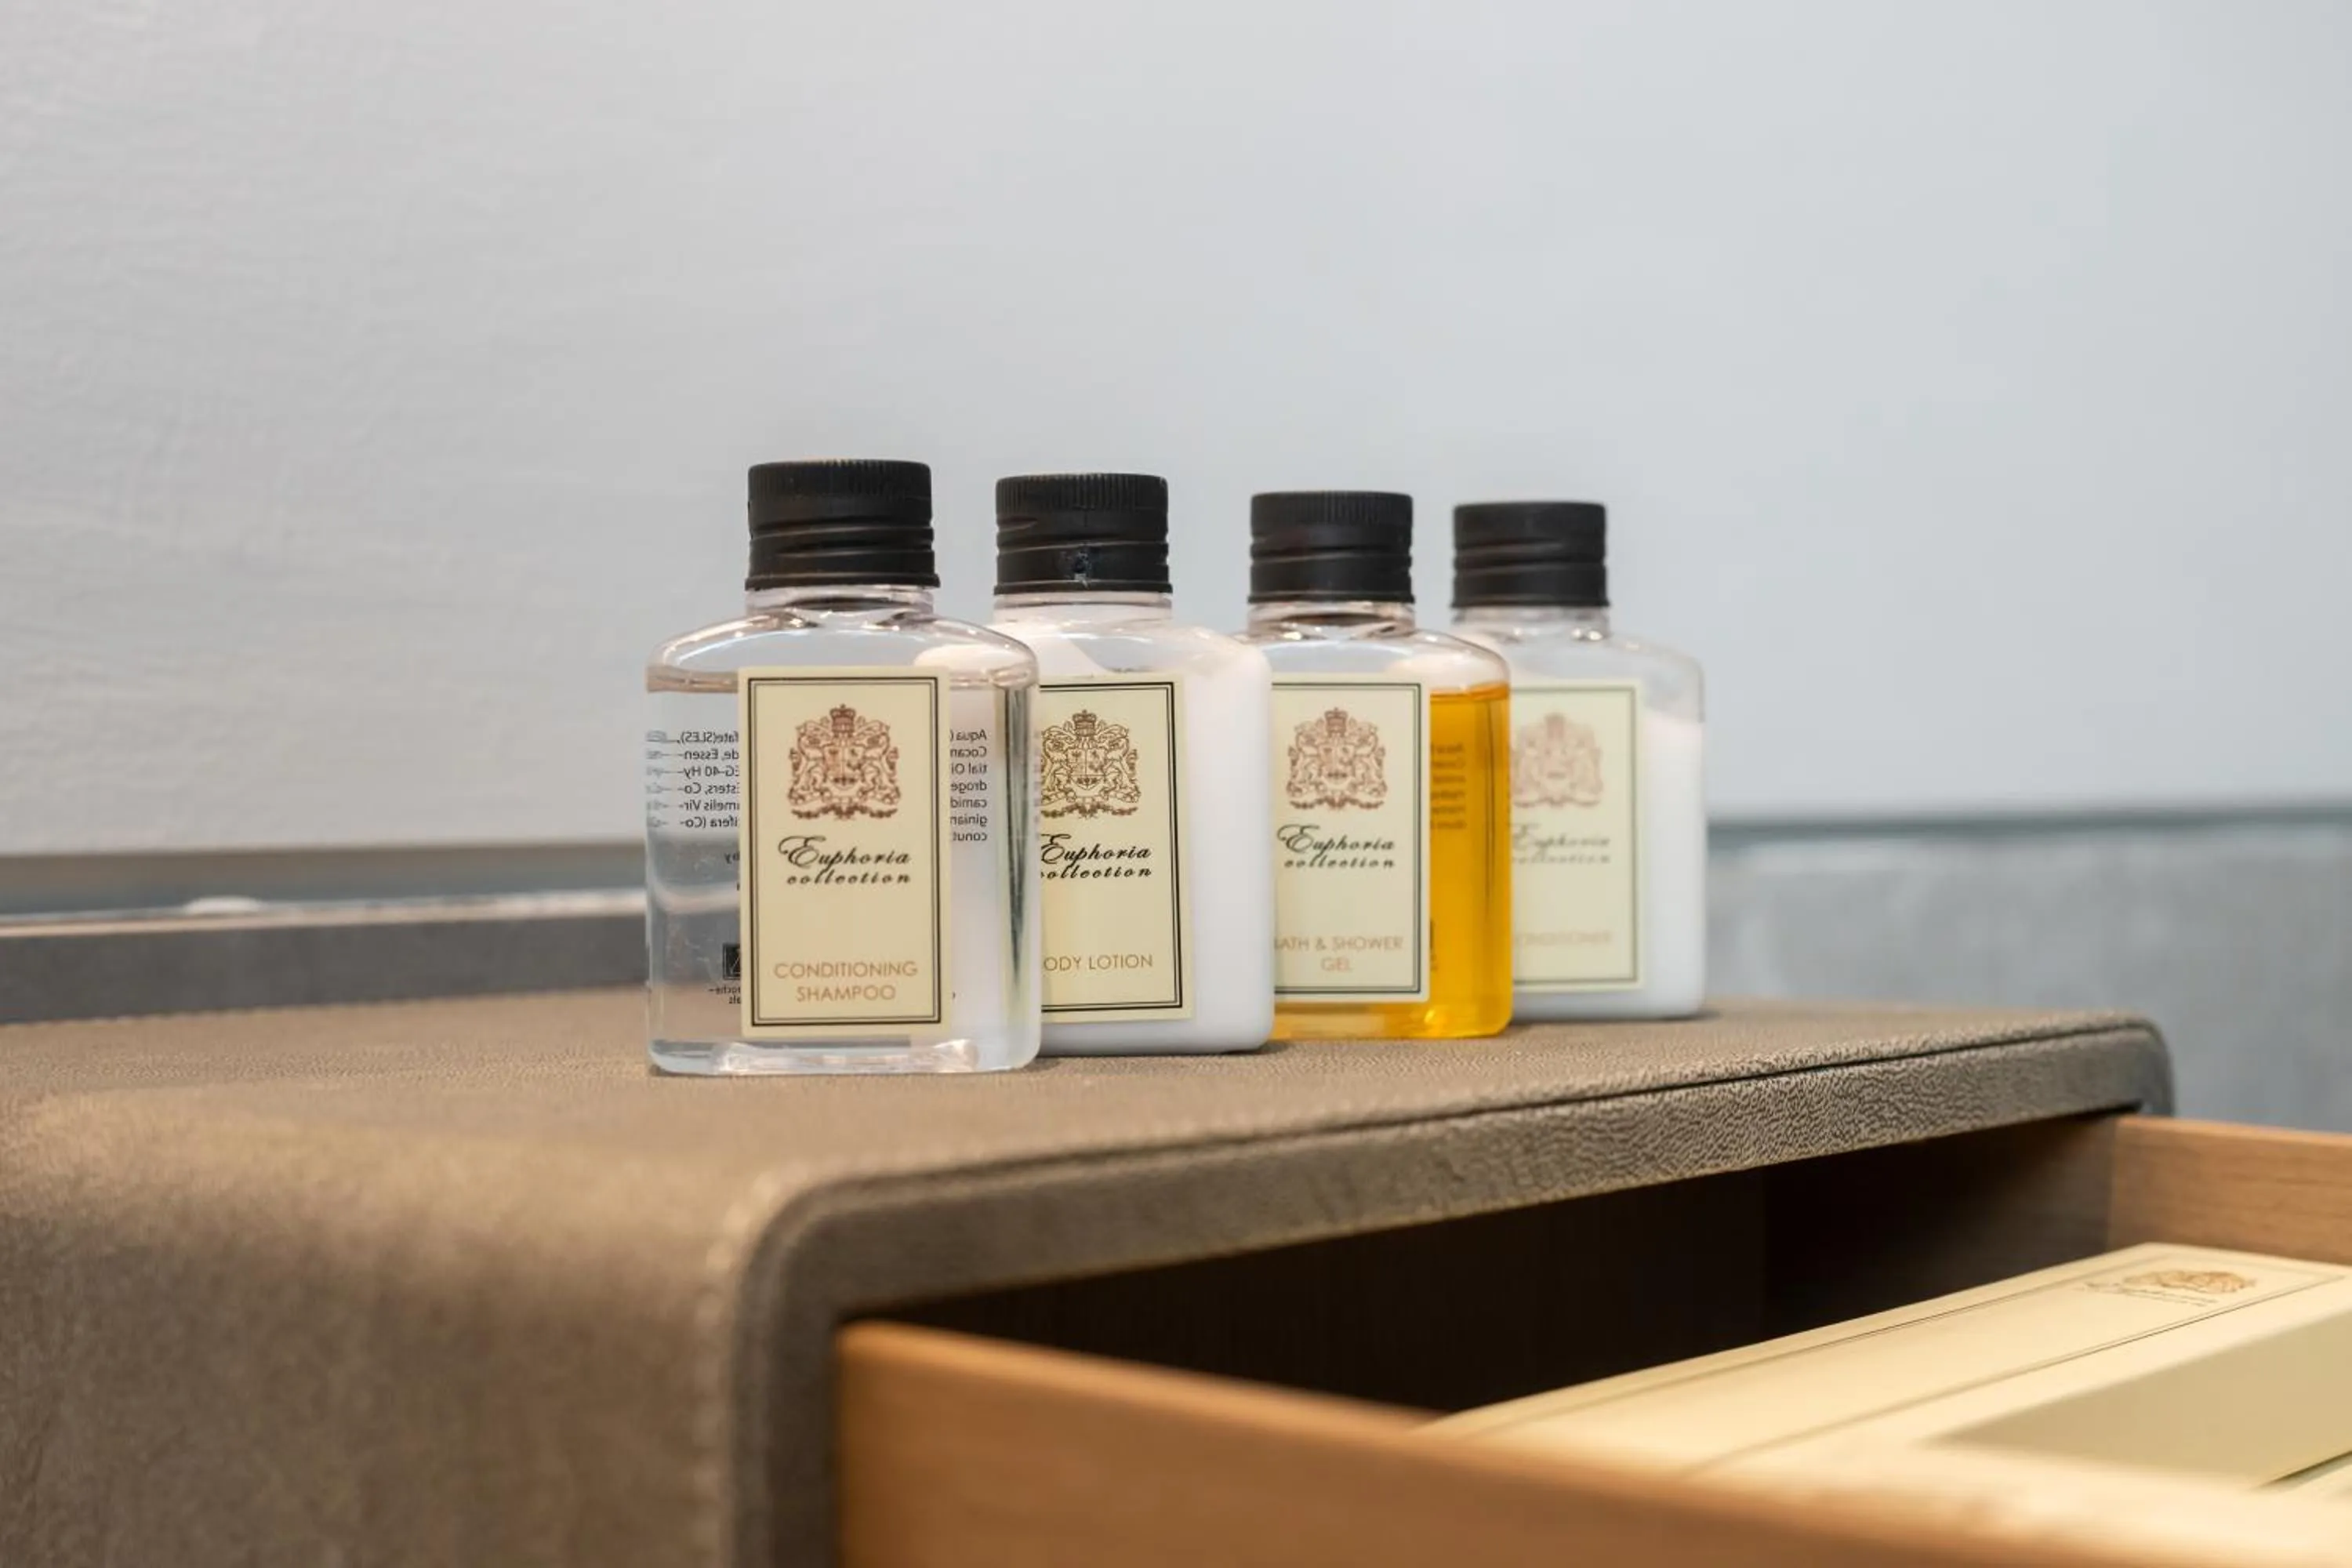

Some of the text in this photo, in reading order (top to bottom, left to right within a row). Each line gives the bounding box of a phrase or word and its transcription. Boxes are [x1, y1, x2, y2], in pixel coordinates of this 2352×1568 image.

[1040, 833, 1152, 868] Euphoria
[1276, 824, 1395, 858] Euphoria
[778, 835, 911, 872] Euphoria
[1284, 855, 1395, 869] collection
[786, 868, 911, 886] collection
[1315, 935, 1327, 951] &
[1331, 935, 1404, 951] SHOWER
[773, 960, 919, 980] CONDITIONING
[1043, 953, 1153, 972] ODY LOTION
[1319, 956, 1352, 973] GEL
[795, 984, 897, 1003] SHAMPOO
